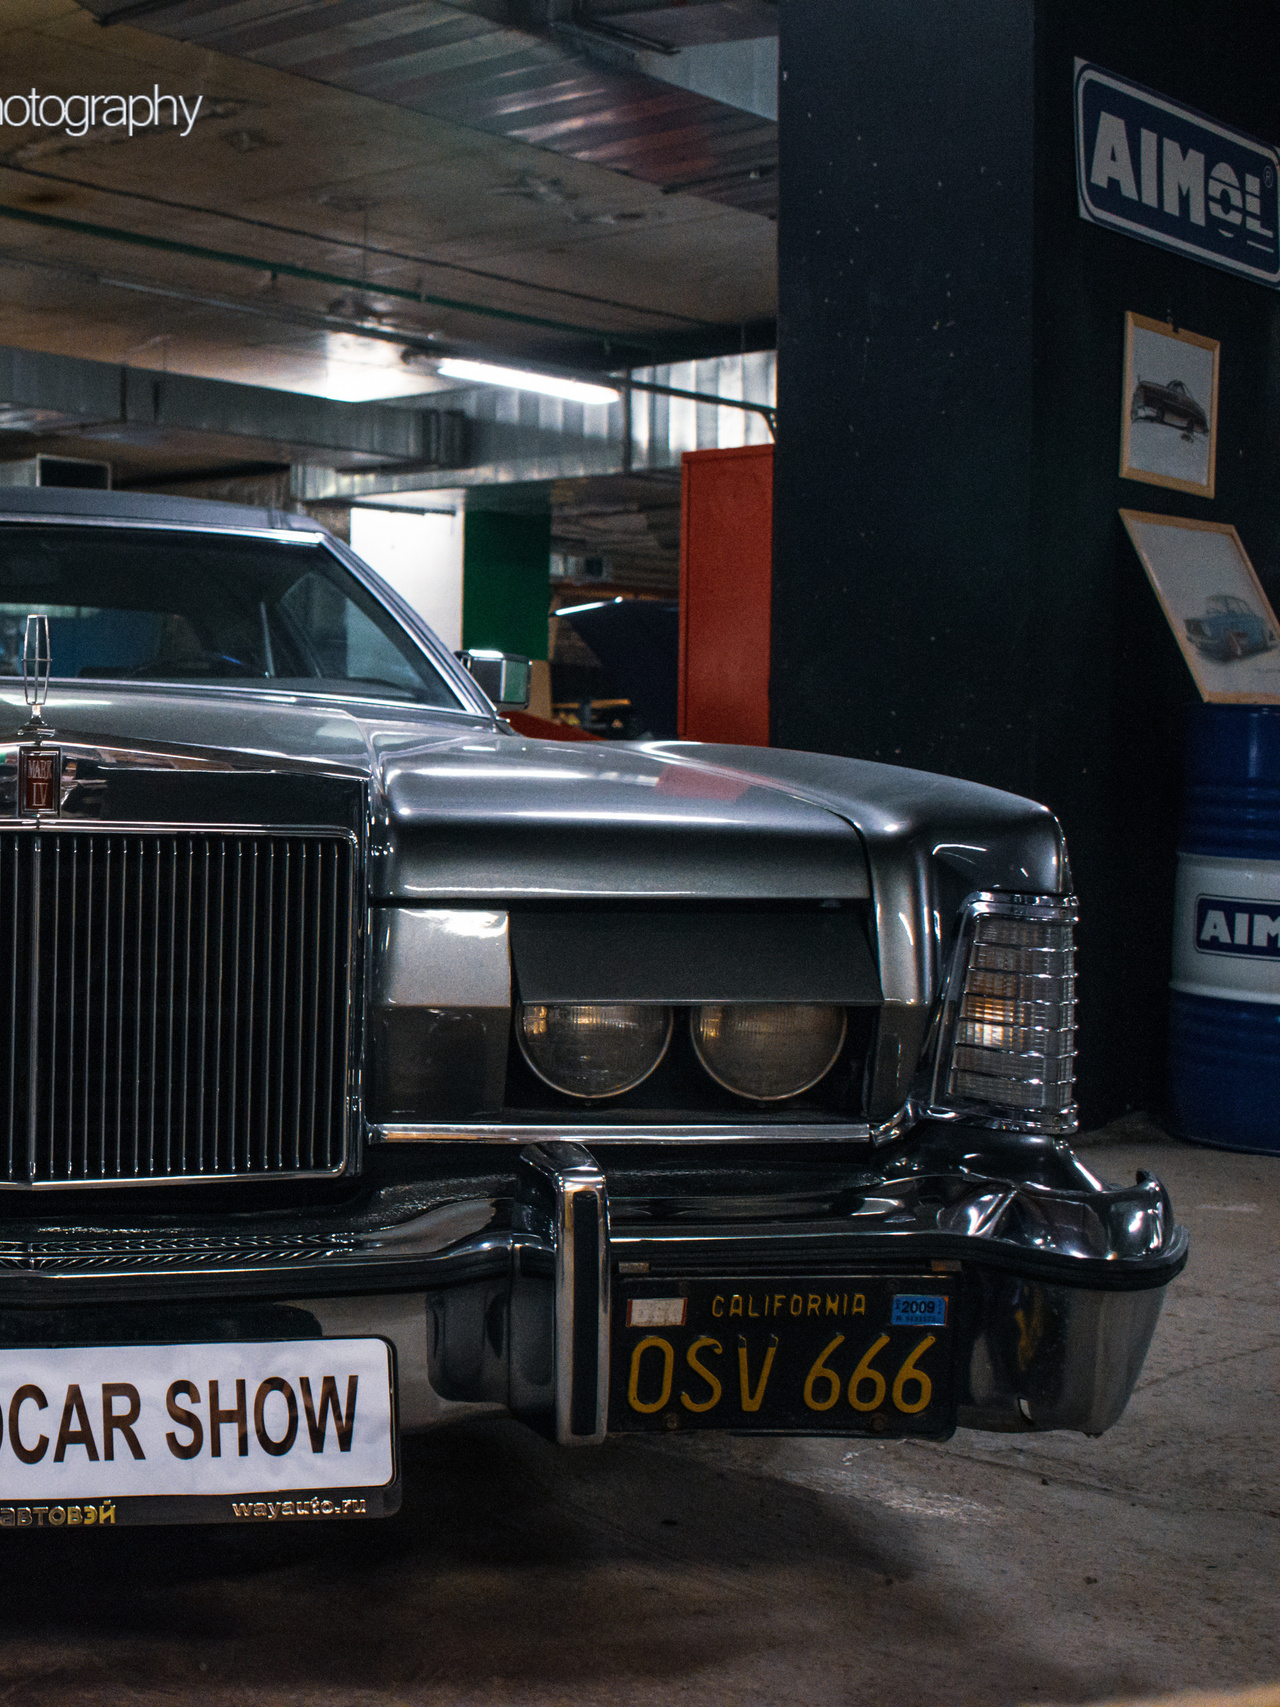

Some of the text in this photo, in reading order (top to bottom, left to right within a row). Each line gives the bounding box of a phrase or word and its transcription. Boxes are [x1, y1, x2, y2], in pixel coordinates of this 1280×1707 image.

[1090, 110, 1275, 254] AIMOL
[27, 759, 53, 780] MARK
[31, 782, 49, 807] IV
[711, 1294, 866, 1318] CALIFORNIA
[901, 1300, 936, 1314] 2009
[627, 1333, 937, 1414] OSV 666
[165, 1374, 360, 1462] SHOW
